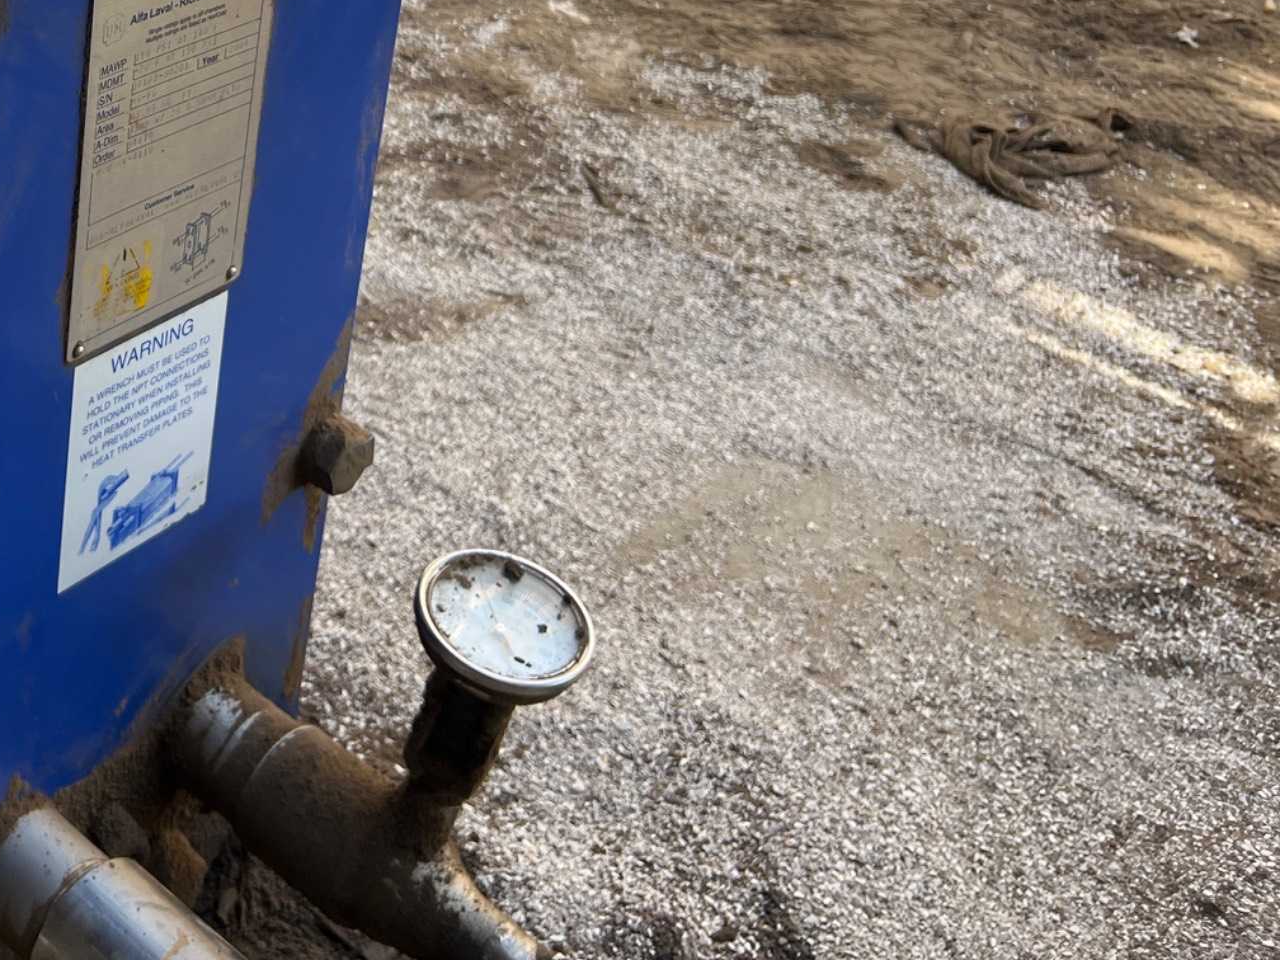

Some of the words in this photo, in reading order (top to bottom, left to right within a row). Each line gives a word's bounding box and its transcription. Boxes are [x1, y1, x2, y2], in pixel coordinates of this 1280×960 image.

[128, 9, 149, 26] Alfa
[149, 1, 174, 19] Laval
[201, 53, 220, 66] Year
[97, 104, 120, 121] Model
[97, 123, 115, 135] Area
[88, 395, 95, 407] A
[96, 375, 135, 401] WRENCH
[136, 360, 161, 380] MUST
[161, 353, 173, 367] BE
[174, 341, 198, 360] USED
[199, 335, 210, 347] TO
[111, 318, 194, 374] WARNING
[81, 400, 136, 436] STATIONARY
[137, 386, 163, 406] WHEN
[164, 359, 211, 391] INSTALLING
[86, 400, 112, 420] HOLD
[113, 390, 130, 405] THE
[131, 380, 149, 397] NPT
[150, 347, 209, 386] CONNECTIONS
[88, 431, 103, 445] OR
[103, 406, 150, 437] REMOVING
[184, 376, 203, 392] THIS
[79, 446, 99, 463] WILL
[102, 421, 141, 451] PREVENT
[142, 401, 178, 429] DAMAGE
[179, 394, 191, 408] TO
[192, 384, 208, 401] THE
[91, 449, 114, 470] HEAT
[116, 424, 161, 455] TRANSFER
